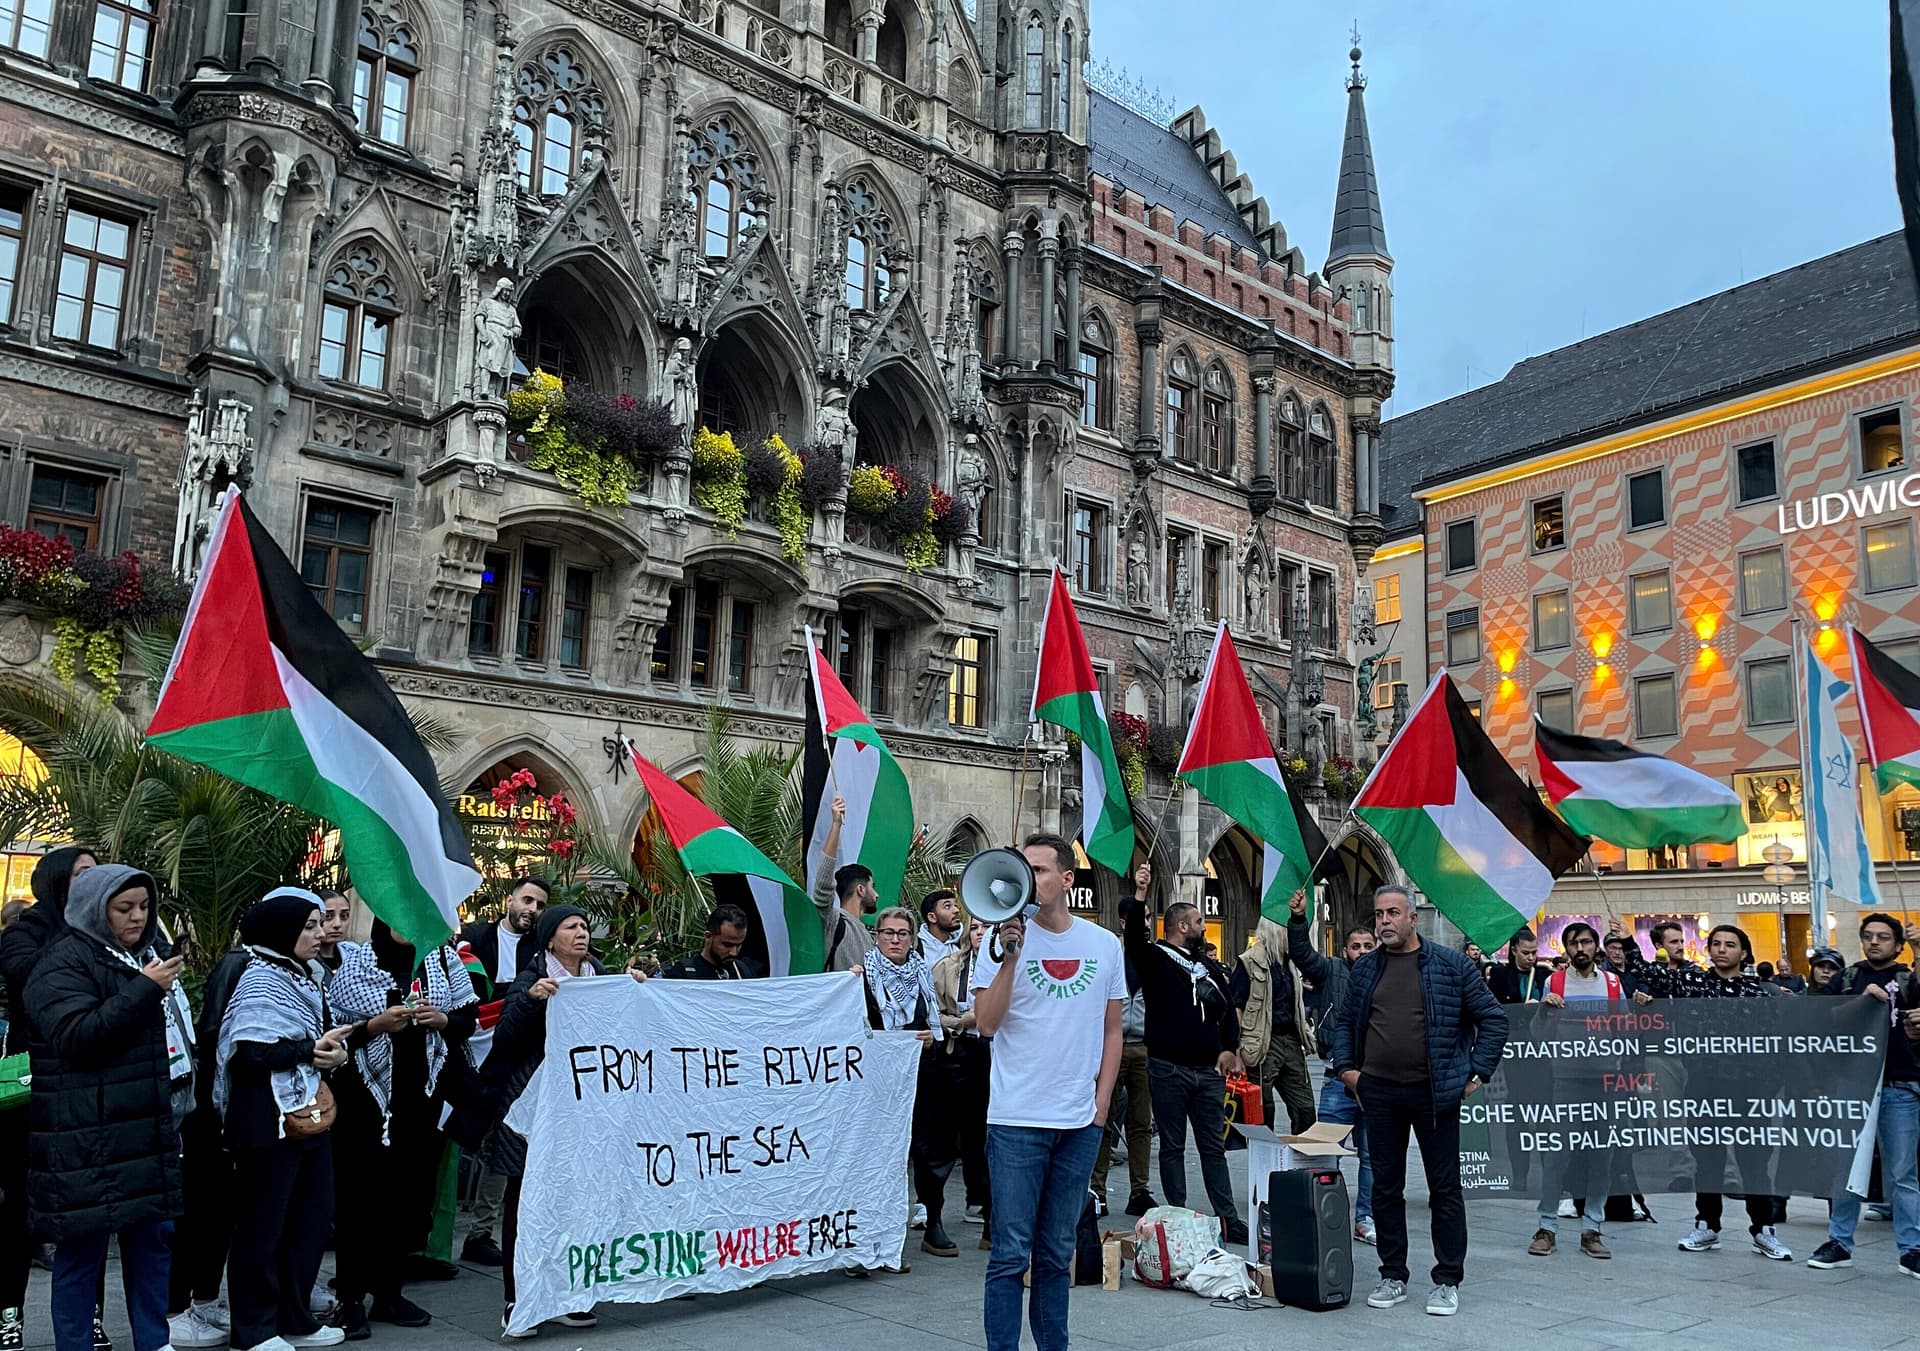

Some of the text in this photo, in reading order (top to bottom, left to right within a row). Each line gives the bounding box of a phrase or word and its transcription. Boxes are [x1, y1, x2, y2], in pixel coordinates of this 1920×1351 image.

[1779, 473, 1920, 535] LUDWIG
[1066, 887, 1093, 908] AYER
[1737, 892, 1789, 905] LUDWIG
[1026, 958, 1098, 1000] FREE PALESTINE
[1585, 1013, 1671, 1032] MYTHOS:
[1502, 1035, 1877, 1059] STAATSRÄSON = SICHERHEIT ISRAELS
[569, 1045, 864, 1101] FROM THE RIVER
[1458, 1104, 1515, 1124] SCHE
[1518, 1101, 1608, 1123] WAFFEN
[1613, 1096, 1657, 1119] FÜR
[1662, 1098, 1742, 1118] ISRAEL
[1747, 1099, 1796, 1118] ZUM
[1519, 1131, 1563, 1152] DES
[1569, 1125, 1799, 1151] PALÄSTINENSISCHEN
[636, 1124, 810, 1187] TO THE SEA
[1459, 1151, 1490, 1162] STINA
[806, 1209, 858, 1257] FREE
